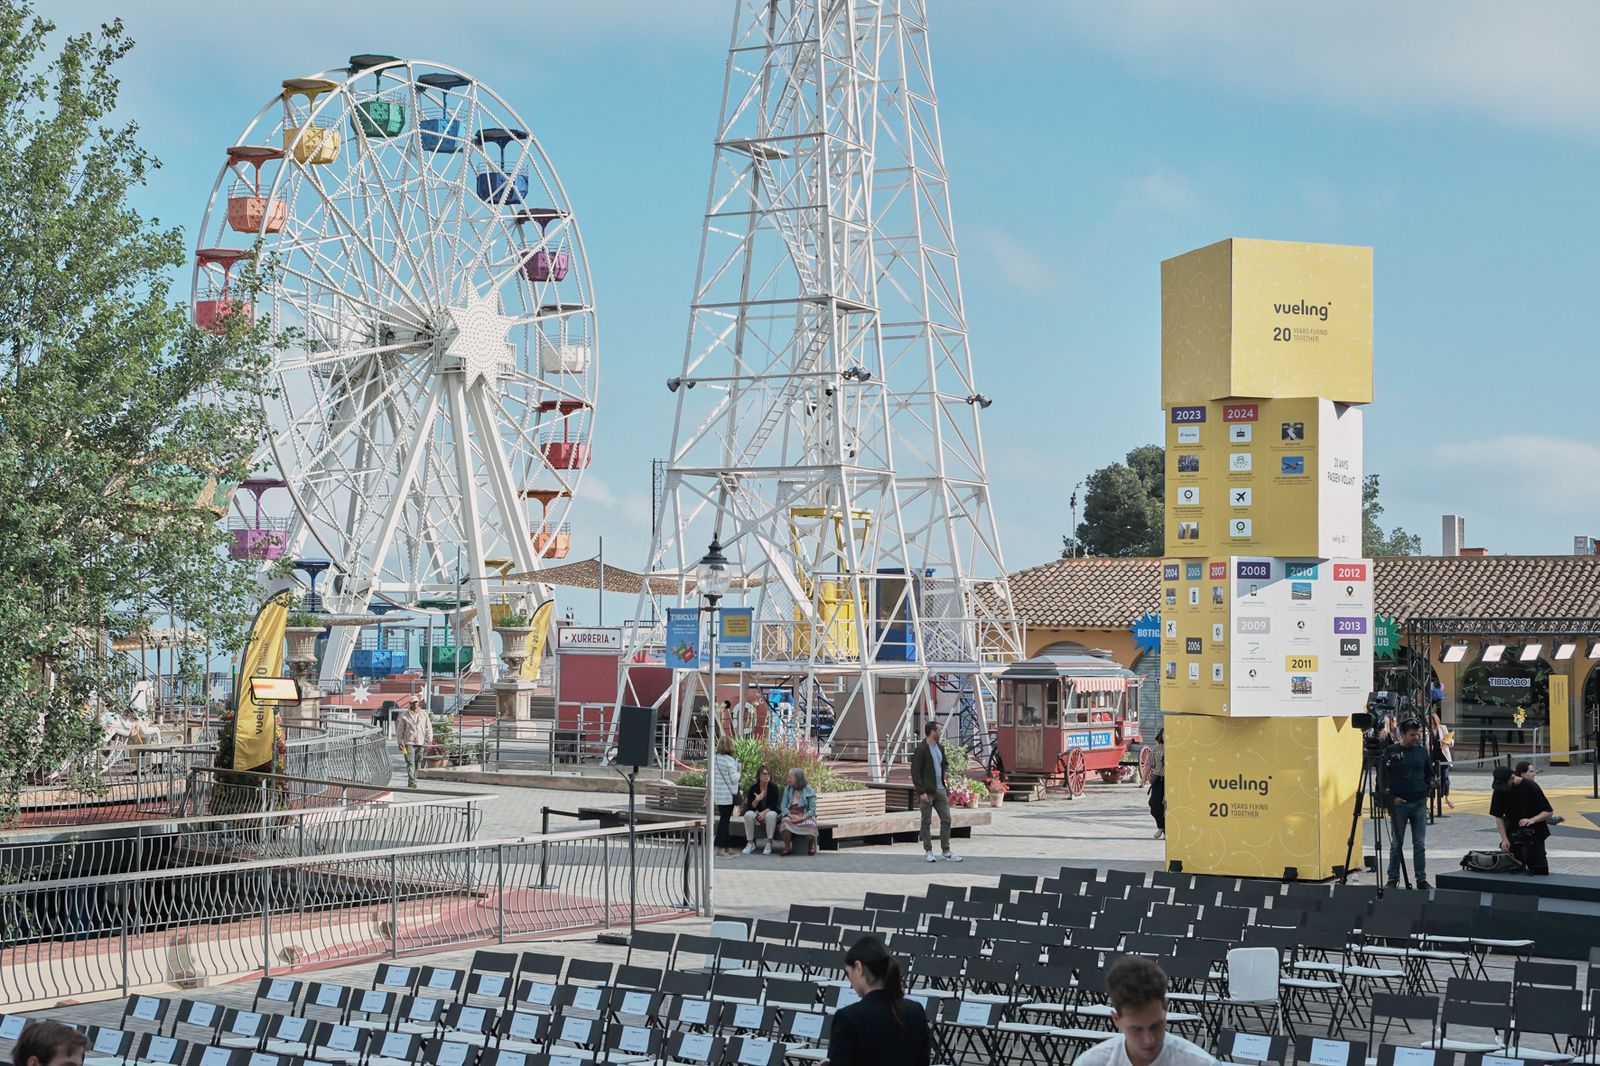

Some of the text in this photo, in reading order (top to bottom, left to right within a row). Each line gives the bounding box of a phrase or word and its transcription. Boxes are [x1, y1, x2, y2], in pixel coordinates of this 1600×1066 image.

[1273, 299, 1328, 321] vueling
[1273, 327, 1291, 341] 20
[1176, 410, 1201, 420] 2023
[1227, 408, 1254, 419] 2024
[1165, 568, 1178, 578] 2004
[1211, 566, 1225, 576] 2007
[1241, 566, 1267, 576] 2008
[1290, 567, 1313, 577] 2010
[1338, 568, 1361, 578] 2012
[1241, 621, 1267, 631] 2009
[1339, 621, 1361, 631] 2013
[1137, 628, 1160, 638] BOTIG
[1375, 627, 1387, 636] IBI
[571, 633, 610, 644] XURRERIA
[1343, 643, 1358, 652] IAG
[1291, 659, 1312, 669] 2011
[1068, 735, 1089, 747] BARBA
[1209, 774, 1268, 796] vueling
[1209, 802, 1229, 817] 20
